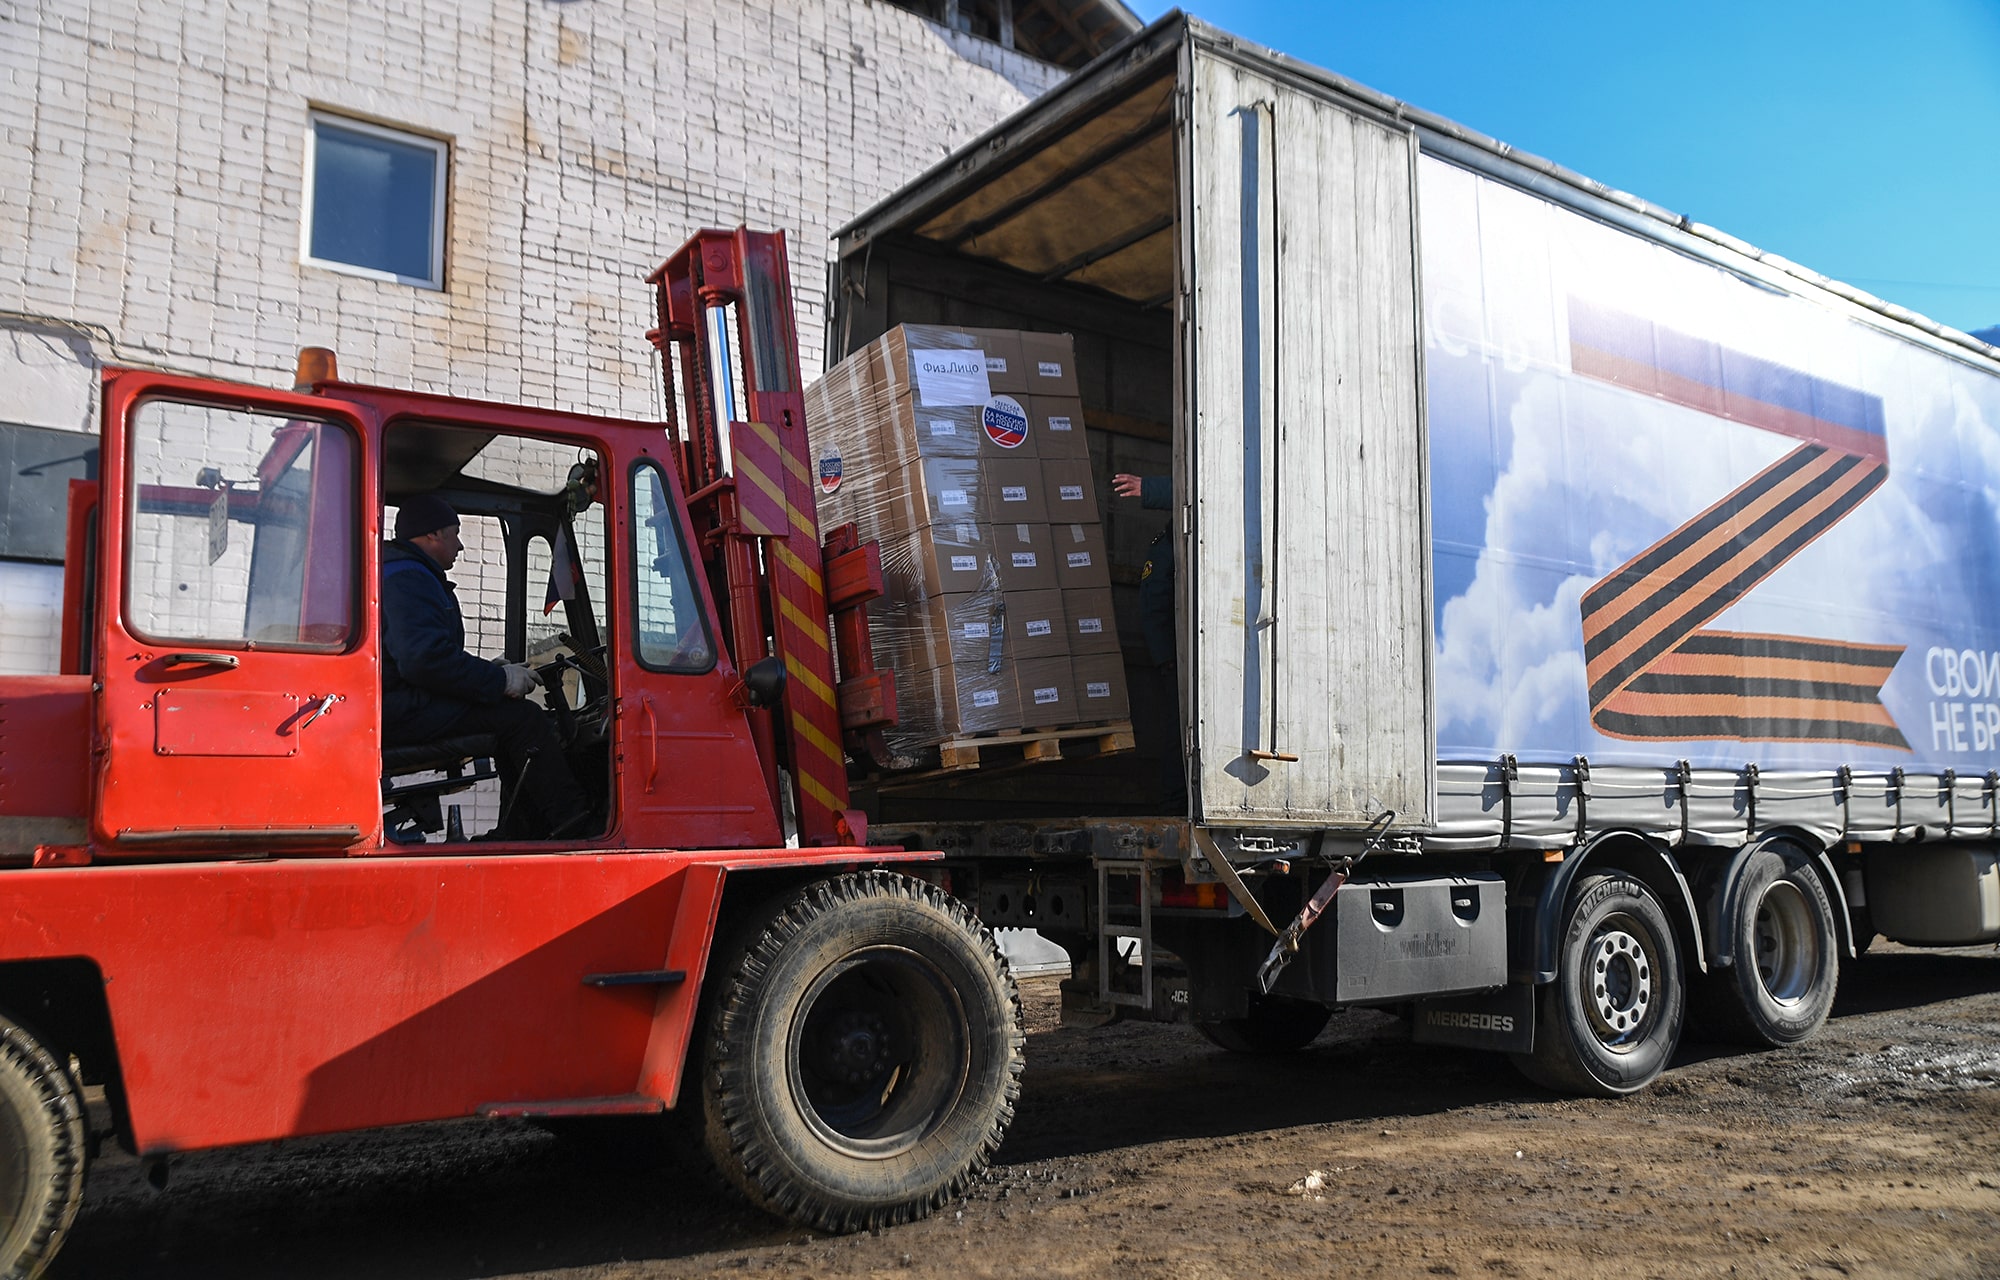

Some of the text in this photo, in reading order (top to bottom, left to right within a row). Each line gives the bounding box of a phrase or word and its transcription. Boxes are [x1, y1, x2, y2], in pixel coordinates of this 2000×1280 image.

[923, 361, 979, 375] Физ.Лицо
[1926, 646, 2000, 699] СВОИ
[1929, 701, 1969, 752] НЕ
[1581, 880, 1639, 918] MICHELIN
[1427, 1011, 1514, 1032] MERCEDES
